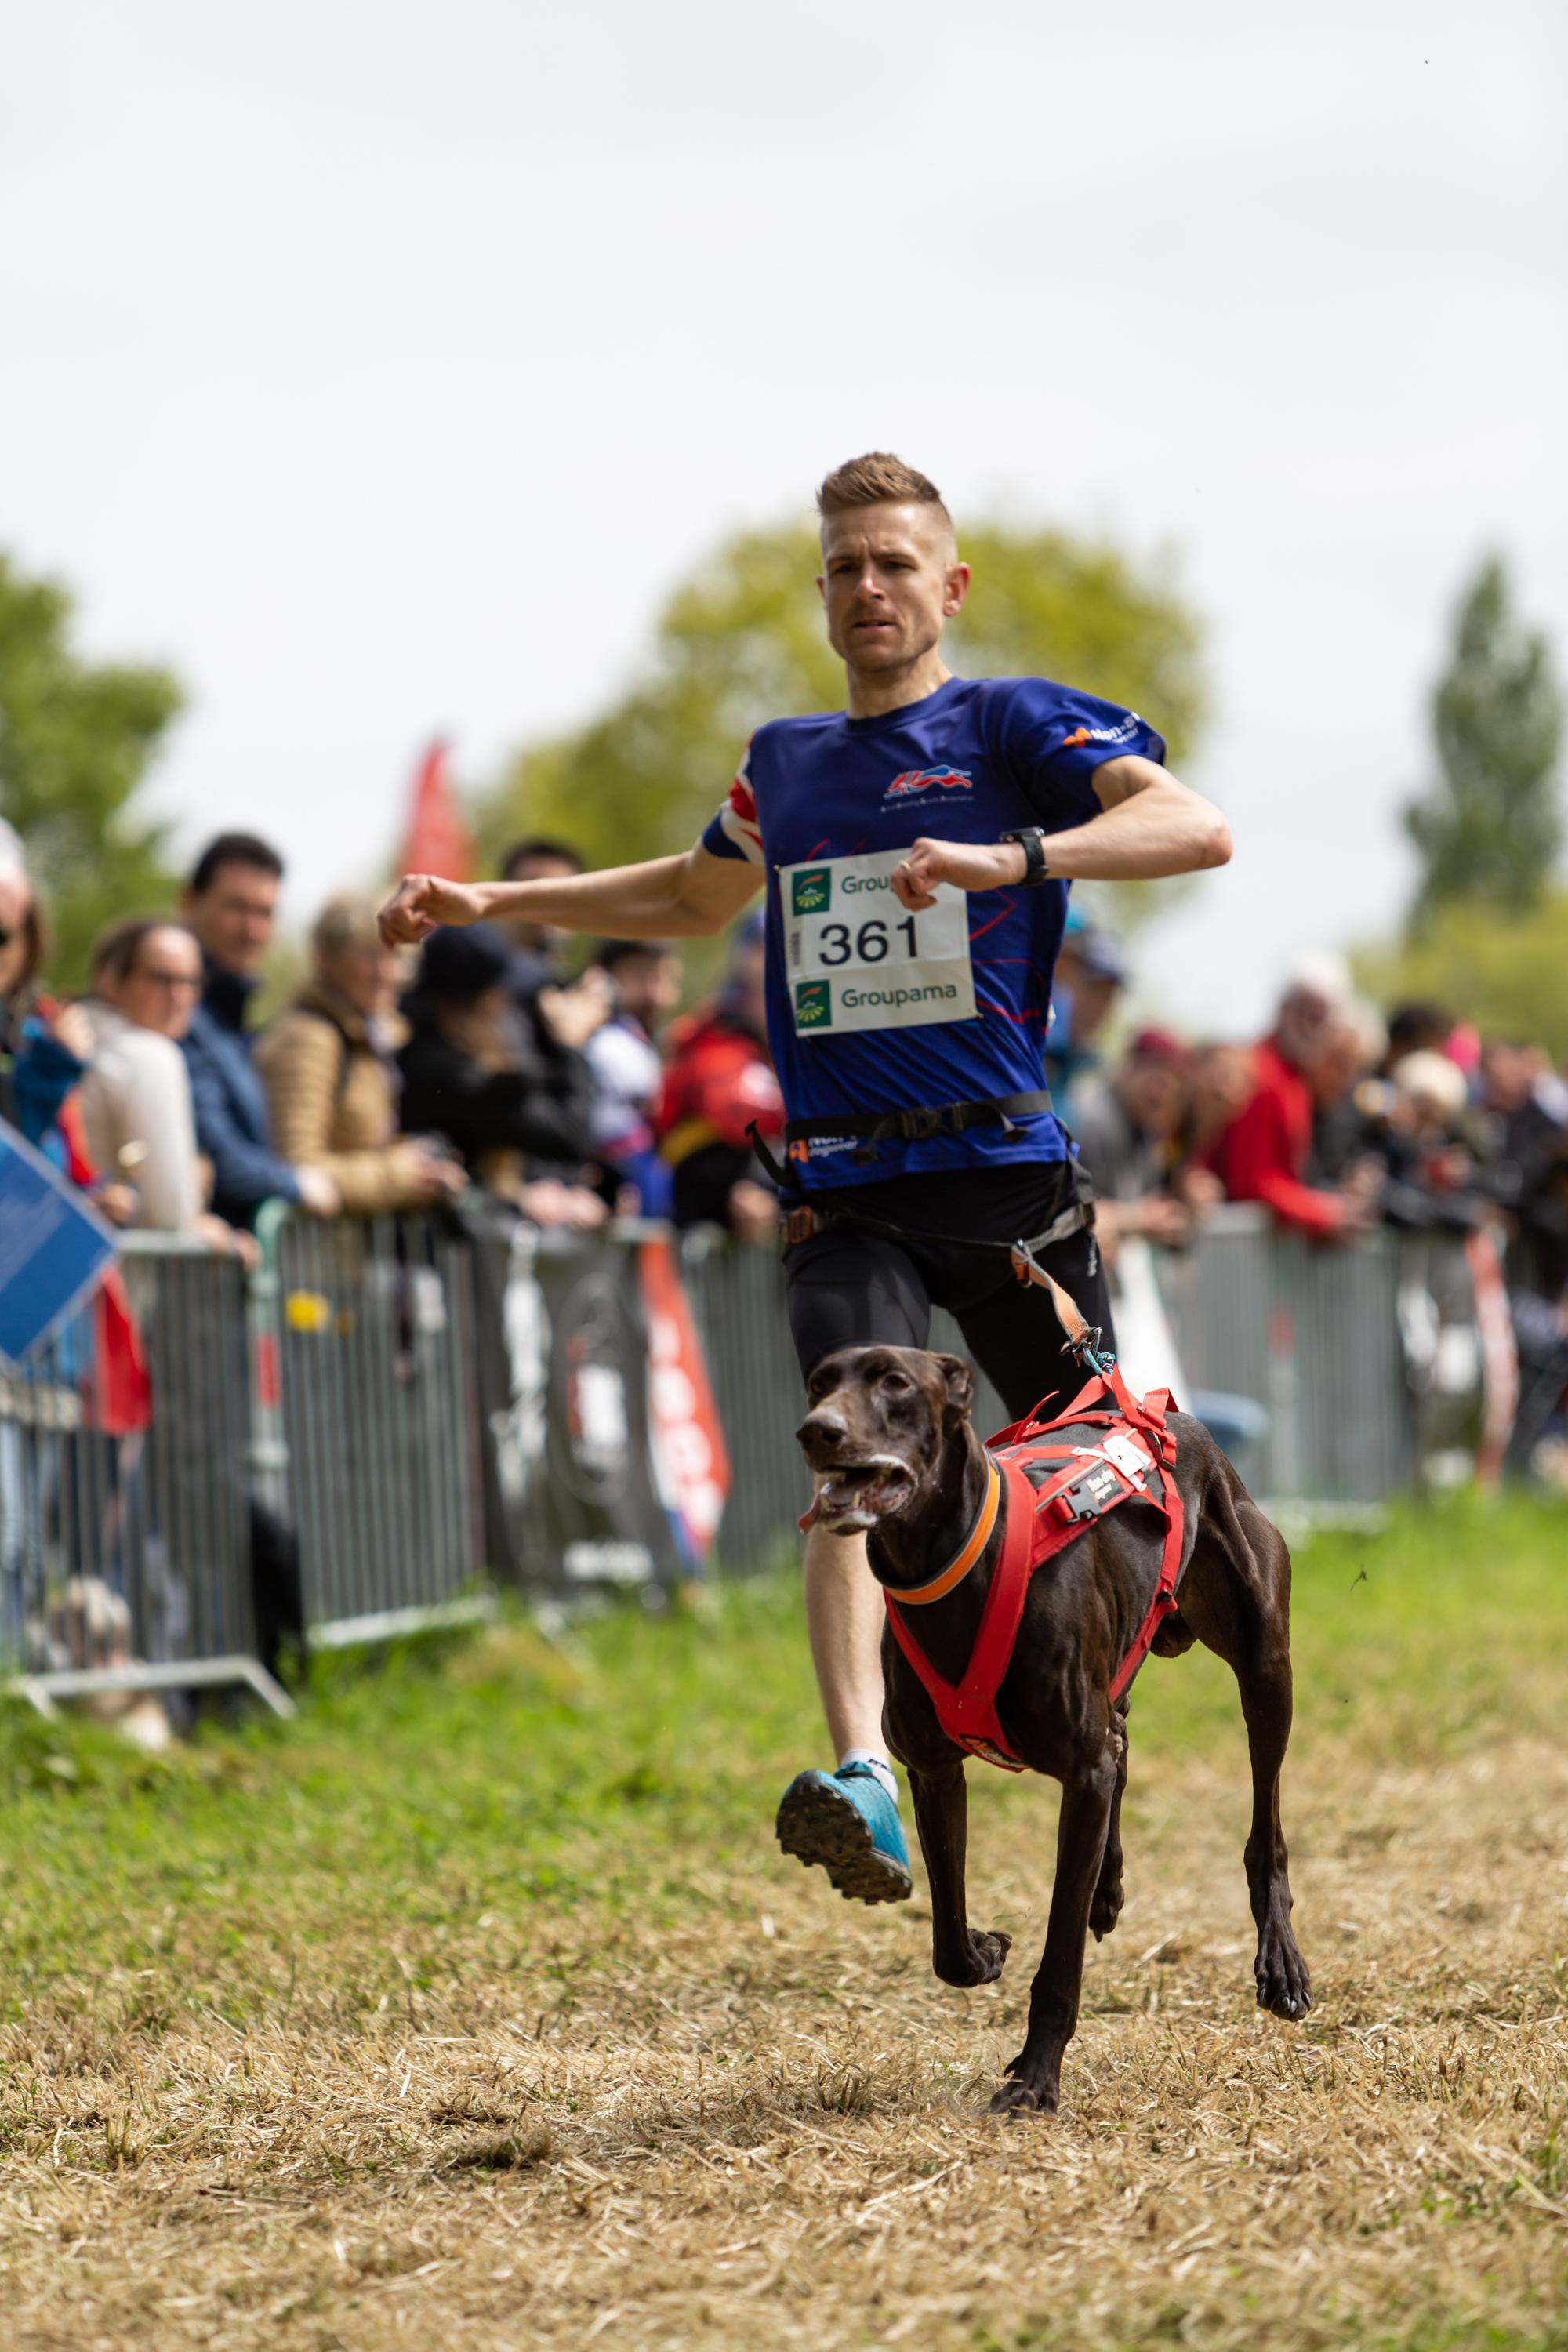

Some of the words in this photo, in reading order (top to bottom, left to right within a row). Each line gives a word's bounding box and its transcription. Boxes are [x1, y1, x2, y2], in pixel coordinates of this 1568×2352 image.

[841, 876, 895, 894] Grou
[818, 916, 918, 965] 361
[841, 984, 957, 1007] Groupama
